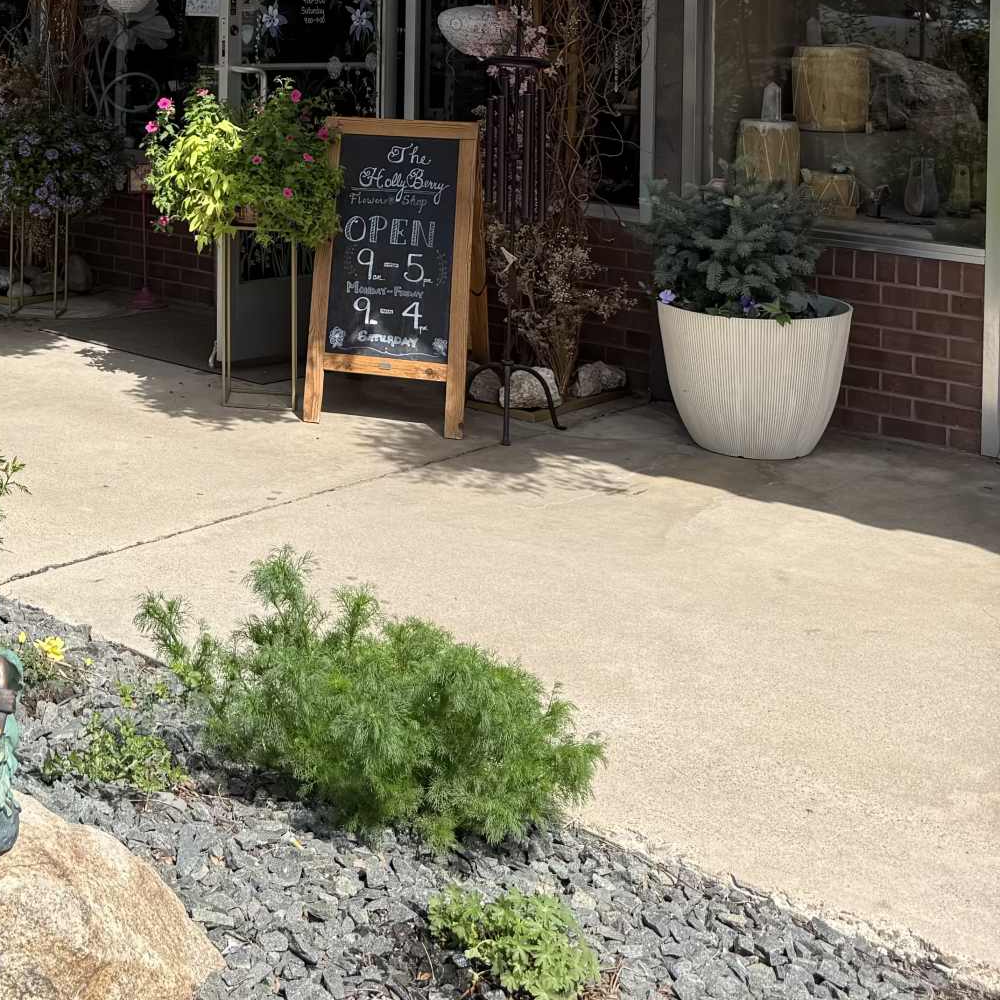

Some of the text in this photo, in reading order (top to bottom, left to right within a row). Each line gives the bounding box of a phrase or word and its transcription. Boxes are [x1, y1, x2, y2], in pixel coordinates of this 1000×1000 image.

[387, 143, 432, 166] The
[402, 194, 427, 214] Shop
[344, 215, 437, 248] OPEN
